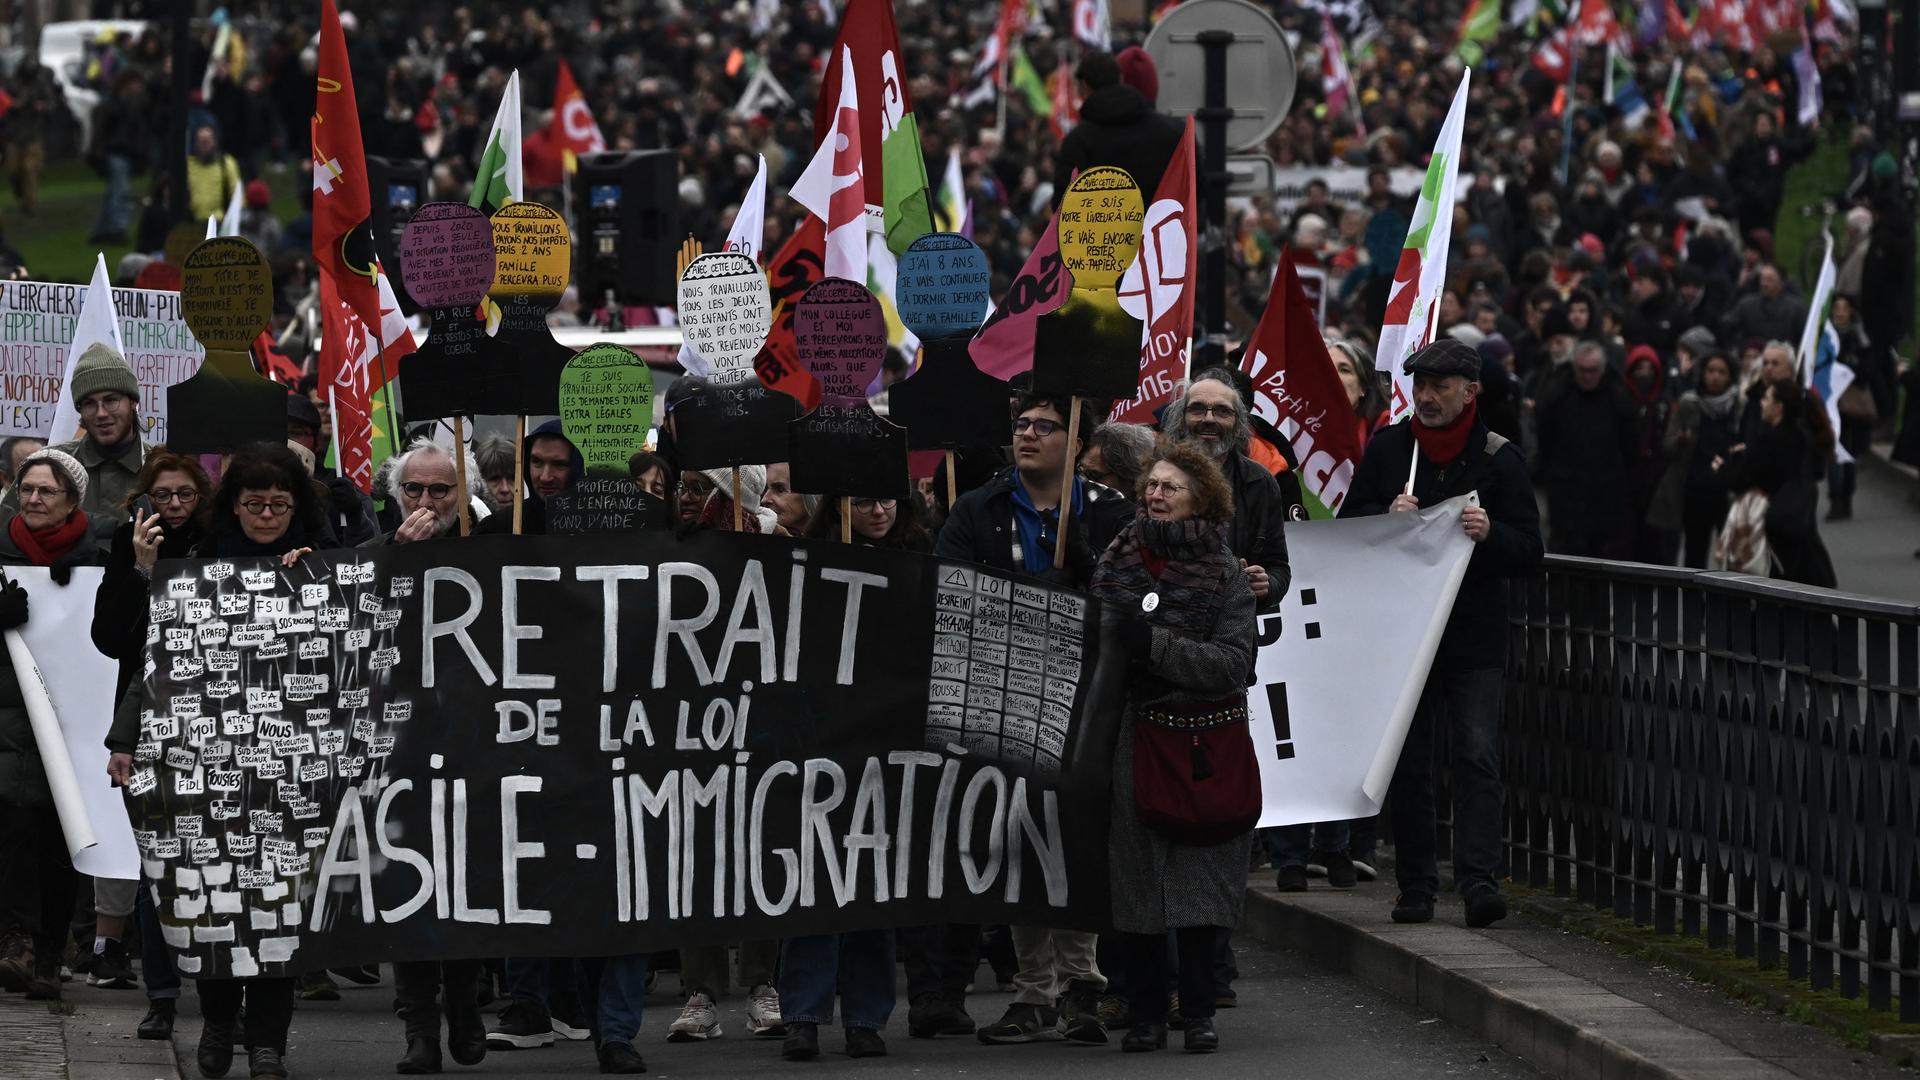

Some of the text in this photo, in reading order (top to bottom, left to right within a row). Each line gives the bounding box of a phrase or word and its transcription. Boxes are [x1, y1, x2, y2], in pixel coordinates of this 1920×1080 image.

[1084, 178, 1116, 187] AVEC CETTE
[1080, 196, 1123, 208] JE SUIS
[1061, 213, 1081, 223] VOTRE
[1086, 212, 1114, 223] LIVREUR
[414, 224, 439, 234] DEPUIS
[515, 223, 560, 234] TRAVAILLONS
[433, 235, 445, 243] VIS
[496, 234, 522, 244] PAYONS
[524, 236, 537, 244] NOS
[1063, 231, 1135, 245] JE VAIS ENCORE
[522, 246, 551, 256] 2 ANS
[1087, 246, 1115, 259] RESTER
[408, 257, 443, 268] AVEC MES
[499, 261, 536, 271] FAMILLE
[692, 260, 744, 275] AVEC CETTE LOI
[938, 255, 945, 270] 8
[952, 256, 974, 268] ANS
[406, 271, 420, 281] MES
[423, 269, 454, 280] REVENUS
[499, 275, 562, 286] PERCEVRA PLUS
[901, 272, 987, 287] JE VAIS CONTINUER
[683, 280, 762, 299] NOUS TRAVAILLONS
[10, 286, 75, 315] LARCHER
[913, 291, 986, 305] DORMIR DEHORS
[682, 296, 760, 312] TOUS LES DEUX.
[453, 306, 471, 318] RUE
[683, 307, 764, 326] NOS ENFANTS ONT
[801, 309, 819, 319] MON
[905, 312, 922, 323] AVEC
[926, 312, 936, 323] MA
[689, 328, 695, 340] 6
[698, 327, 711, 338] ANS
[717, 325, 725, 335] ET
[729, 323, 736, 335] 6
[814, 321, 853, 331] ET MOI
[699, 338, 759, 353] NOS REVENUS
[797, 335, 883, 345] NE PERCEVRONS PLUS
[799, 348, 812, 358] LES
[46, 348, 64, 376] LA
[714, 354, 742, 368] VONT
[810, 362, 866, 372] ALORS QUE
[581, 371, 621, 382] JE SUIS
[714, 370, 746, 384] CHUTER
[824, 375, 852, 383] NOUS
[561, 383, 613, 394] TRAVAILLEUR
[825, 385, 861, 395] PAYONS
[562, 396, 648, 406] LES DEMANDES D'AIDE
[1260, 369, 1327, 432] Parti de
[565, 406, 631, 420] EXTRA LÉGALES
[819, 406, 835, 418] LES
[568, 425, 592, 434] VONT
[556, 498, 571, 510] DE
[208, 565, 231, 573] SOLEX
[304, 589, 322, 599] FSE
[1015, 589, 1045, 604] RACISTE
[192, 611, 202, 619] 33
[171, 631, 189, 639] LDH
[200, 628, 227, 640] APAFED
[290, 676, 314, 685] UNION
[931, 684, 960, 697] POUSSE
[226, 716, 250, 724] ATTAC
[495, 699, 561, 746] DE
[599, 697, 656, 752] LA
[259, 721, 291, 738] NOUS
[321, 736, 342, 745] CIMADE
[230, 838, 254, 846] UNEF
